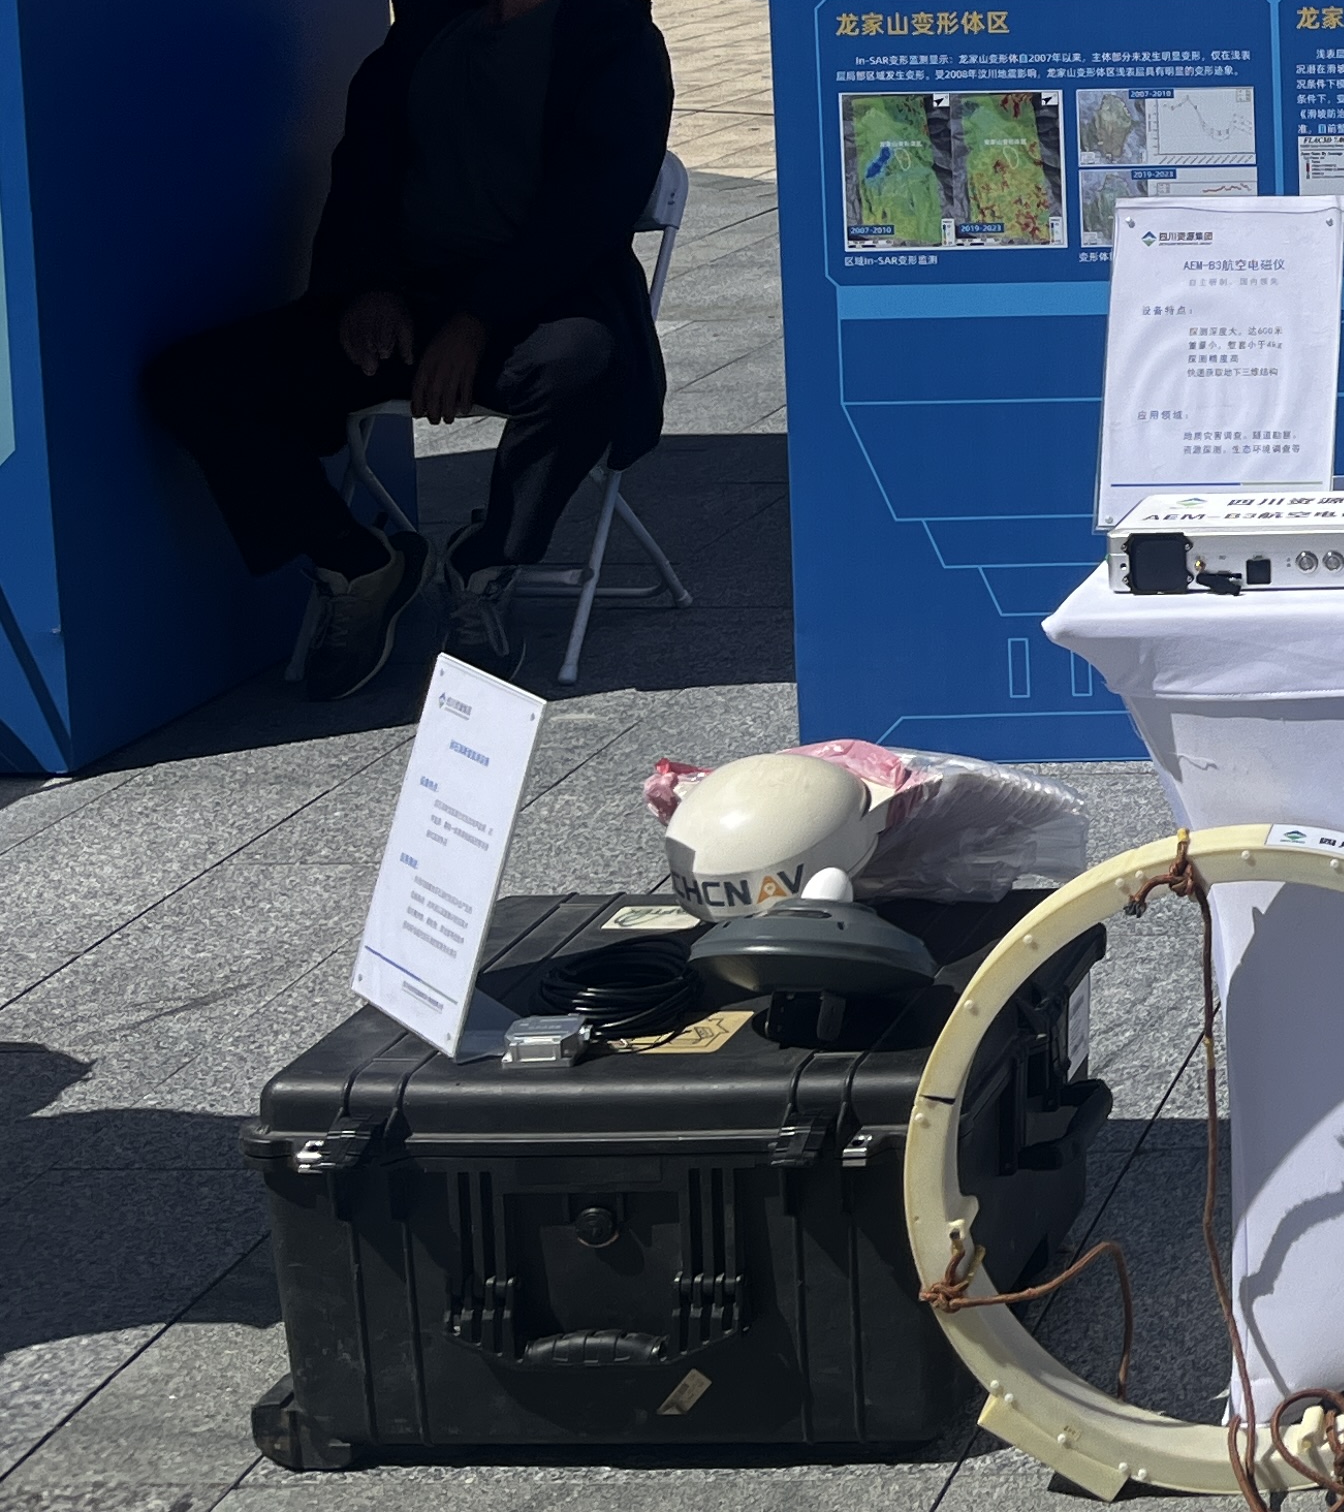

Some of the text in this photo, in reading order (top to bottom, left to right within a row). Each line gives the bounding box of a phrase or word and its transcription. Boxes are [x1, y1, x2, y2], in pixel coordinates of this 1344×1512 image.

[835, 10, 1011, 37] 龙家山变形体区
[1158, 231, 1214, 242] 四川资源集团
[1183, 258, 1286, 271] AEM-B3航空电磁仪
[670, 864, 805, 908] CHCNAV
